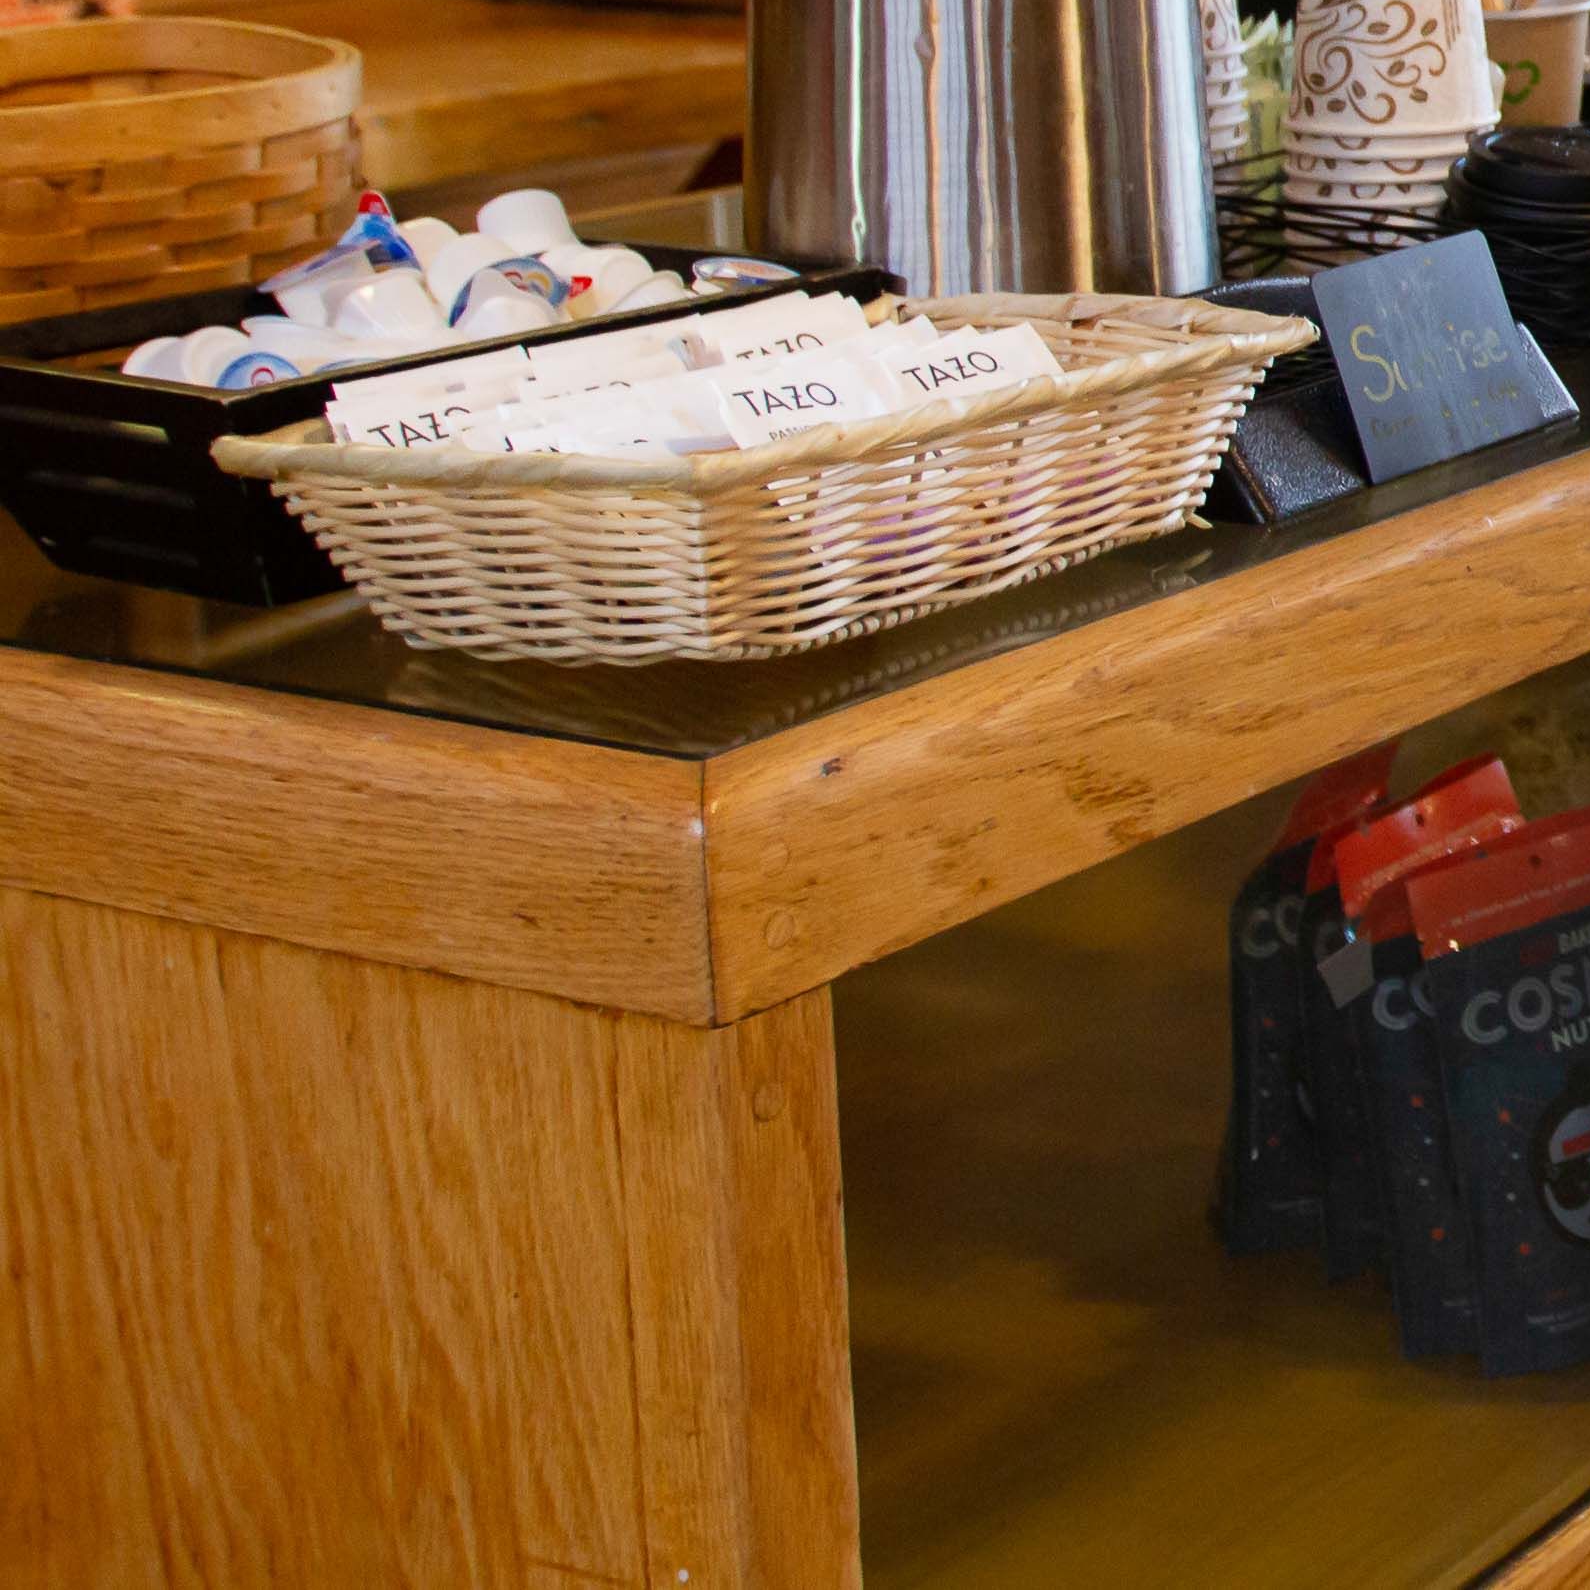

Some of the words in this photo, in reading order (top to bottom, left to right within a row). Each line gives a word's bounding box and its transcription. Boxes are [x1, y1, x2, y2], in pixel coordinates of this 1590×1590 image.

[736, 332, 824, 359] ZO
[901, 350, 1000, 393] TAZO
[732, 381, 838, 418] TAZO
